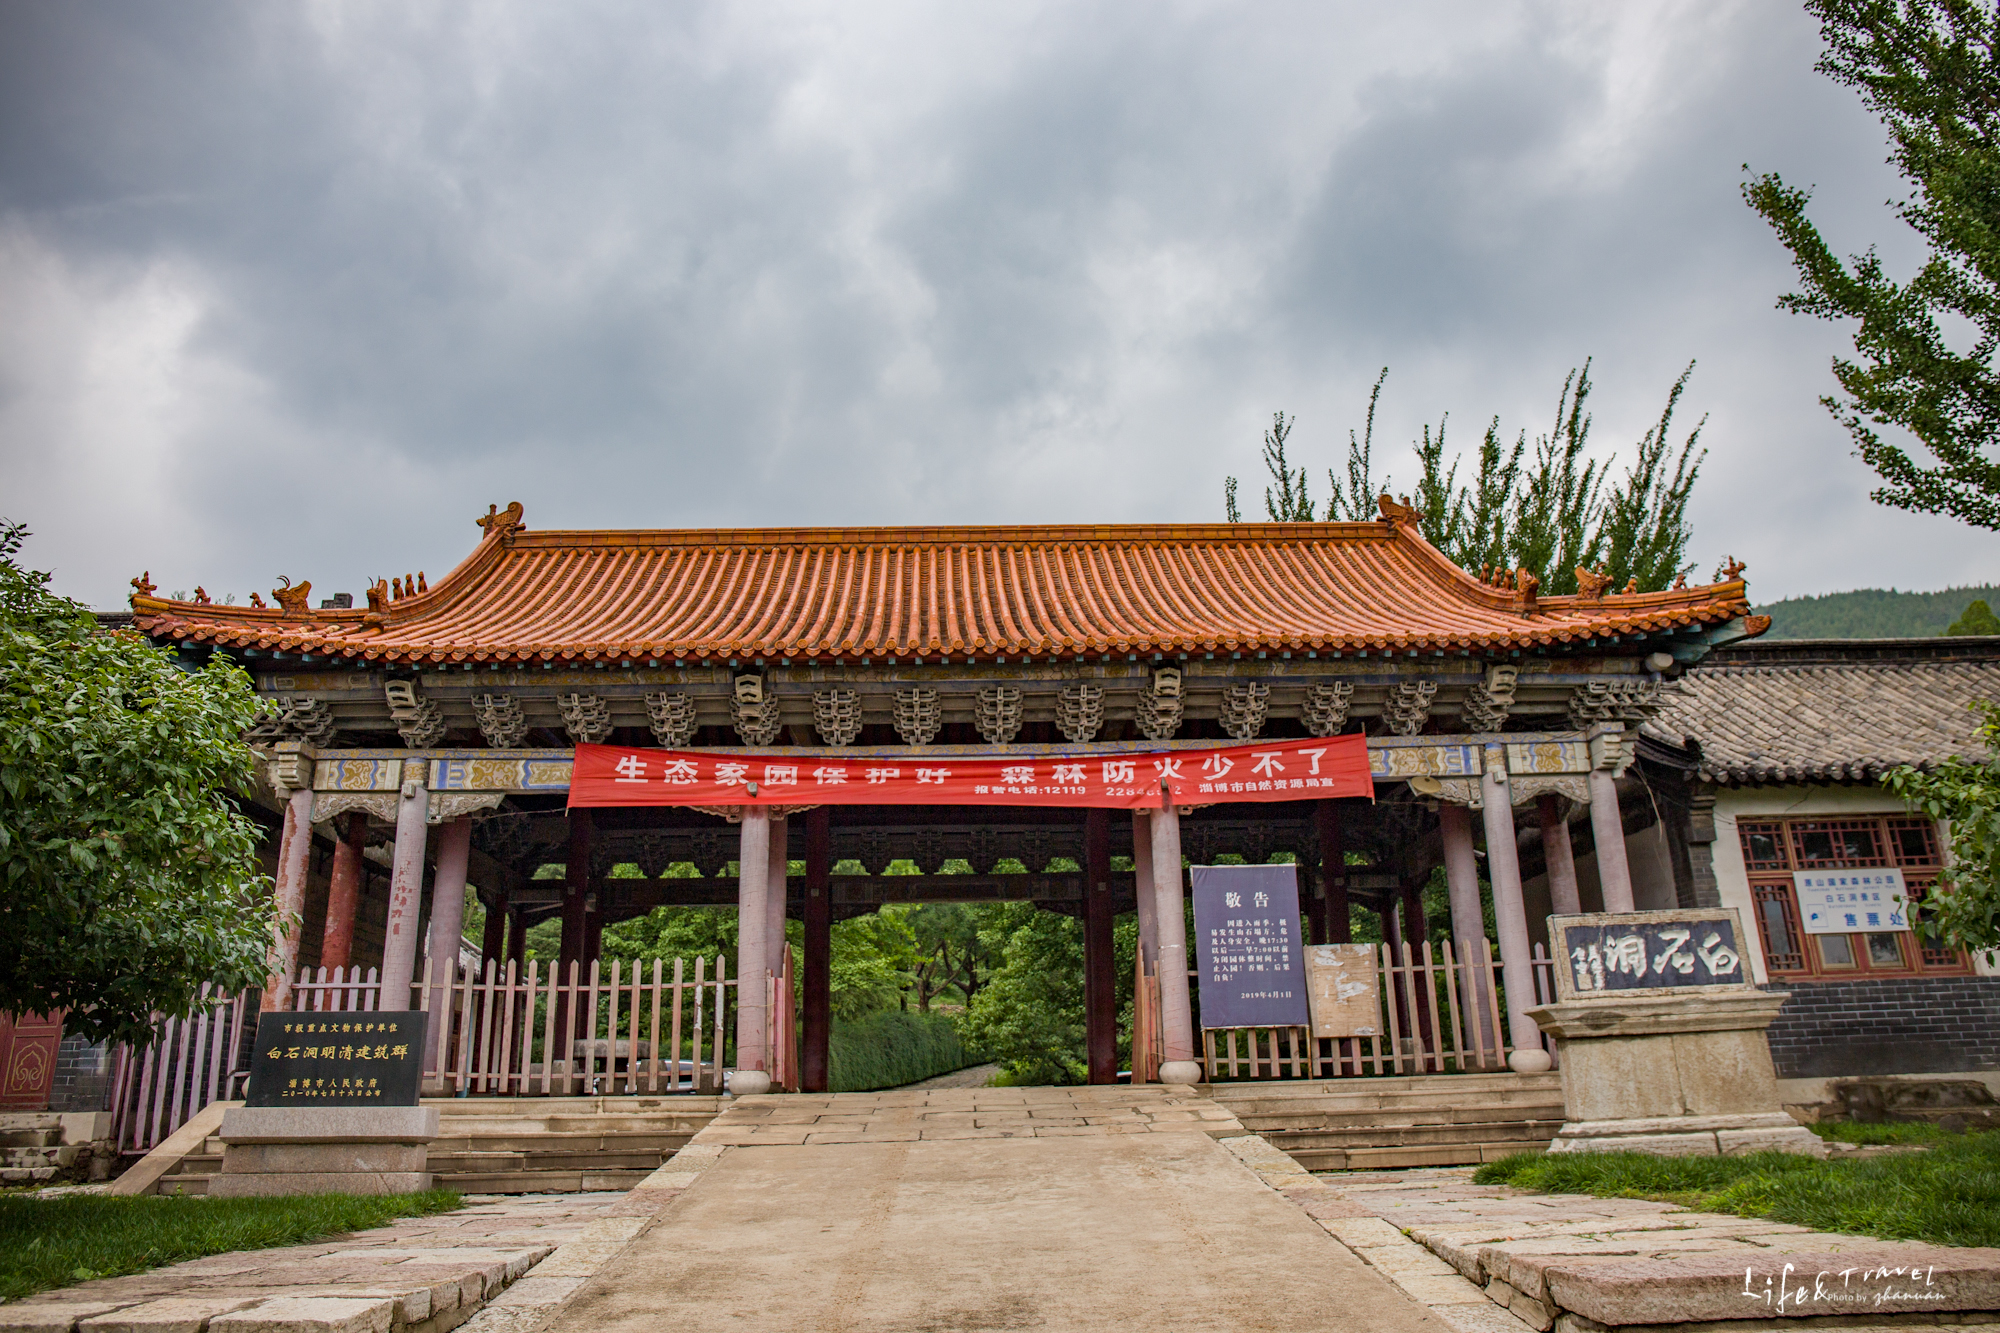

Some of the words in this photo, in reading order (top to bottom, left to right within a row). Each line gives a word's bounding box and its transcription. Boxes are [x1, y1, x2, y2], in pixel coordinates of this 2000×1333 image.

[614, 755, 952, 785] 生态家园保护好
[1000, 748, 1328, 785] 森林防火少不了
[1198, 777, 1335, 794] 淄博市自然资源局宣
[1843, 912, 1905, 927] 售票处
[1240, 991, 1292, 999] 2019年4月1日
[284, 1023, 398, 1033] 市级重点文物保护单位
[267, 1043, 409, 1061] 白石洞明清建筑群
[288, 1078, 378, 1088] 淄博市人民政府
